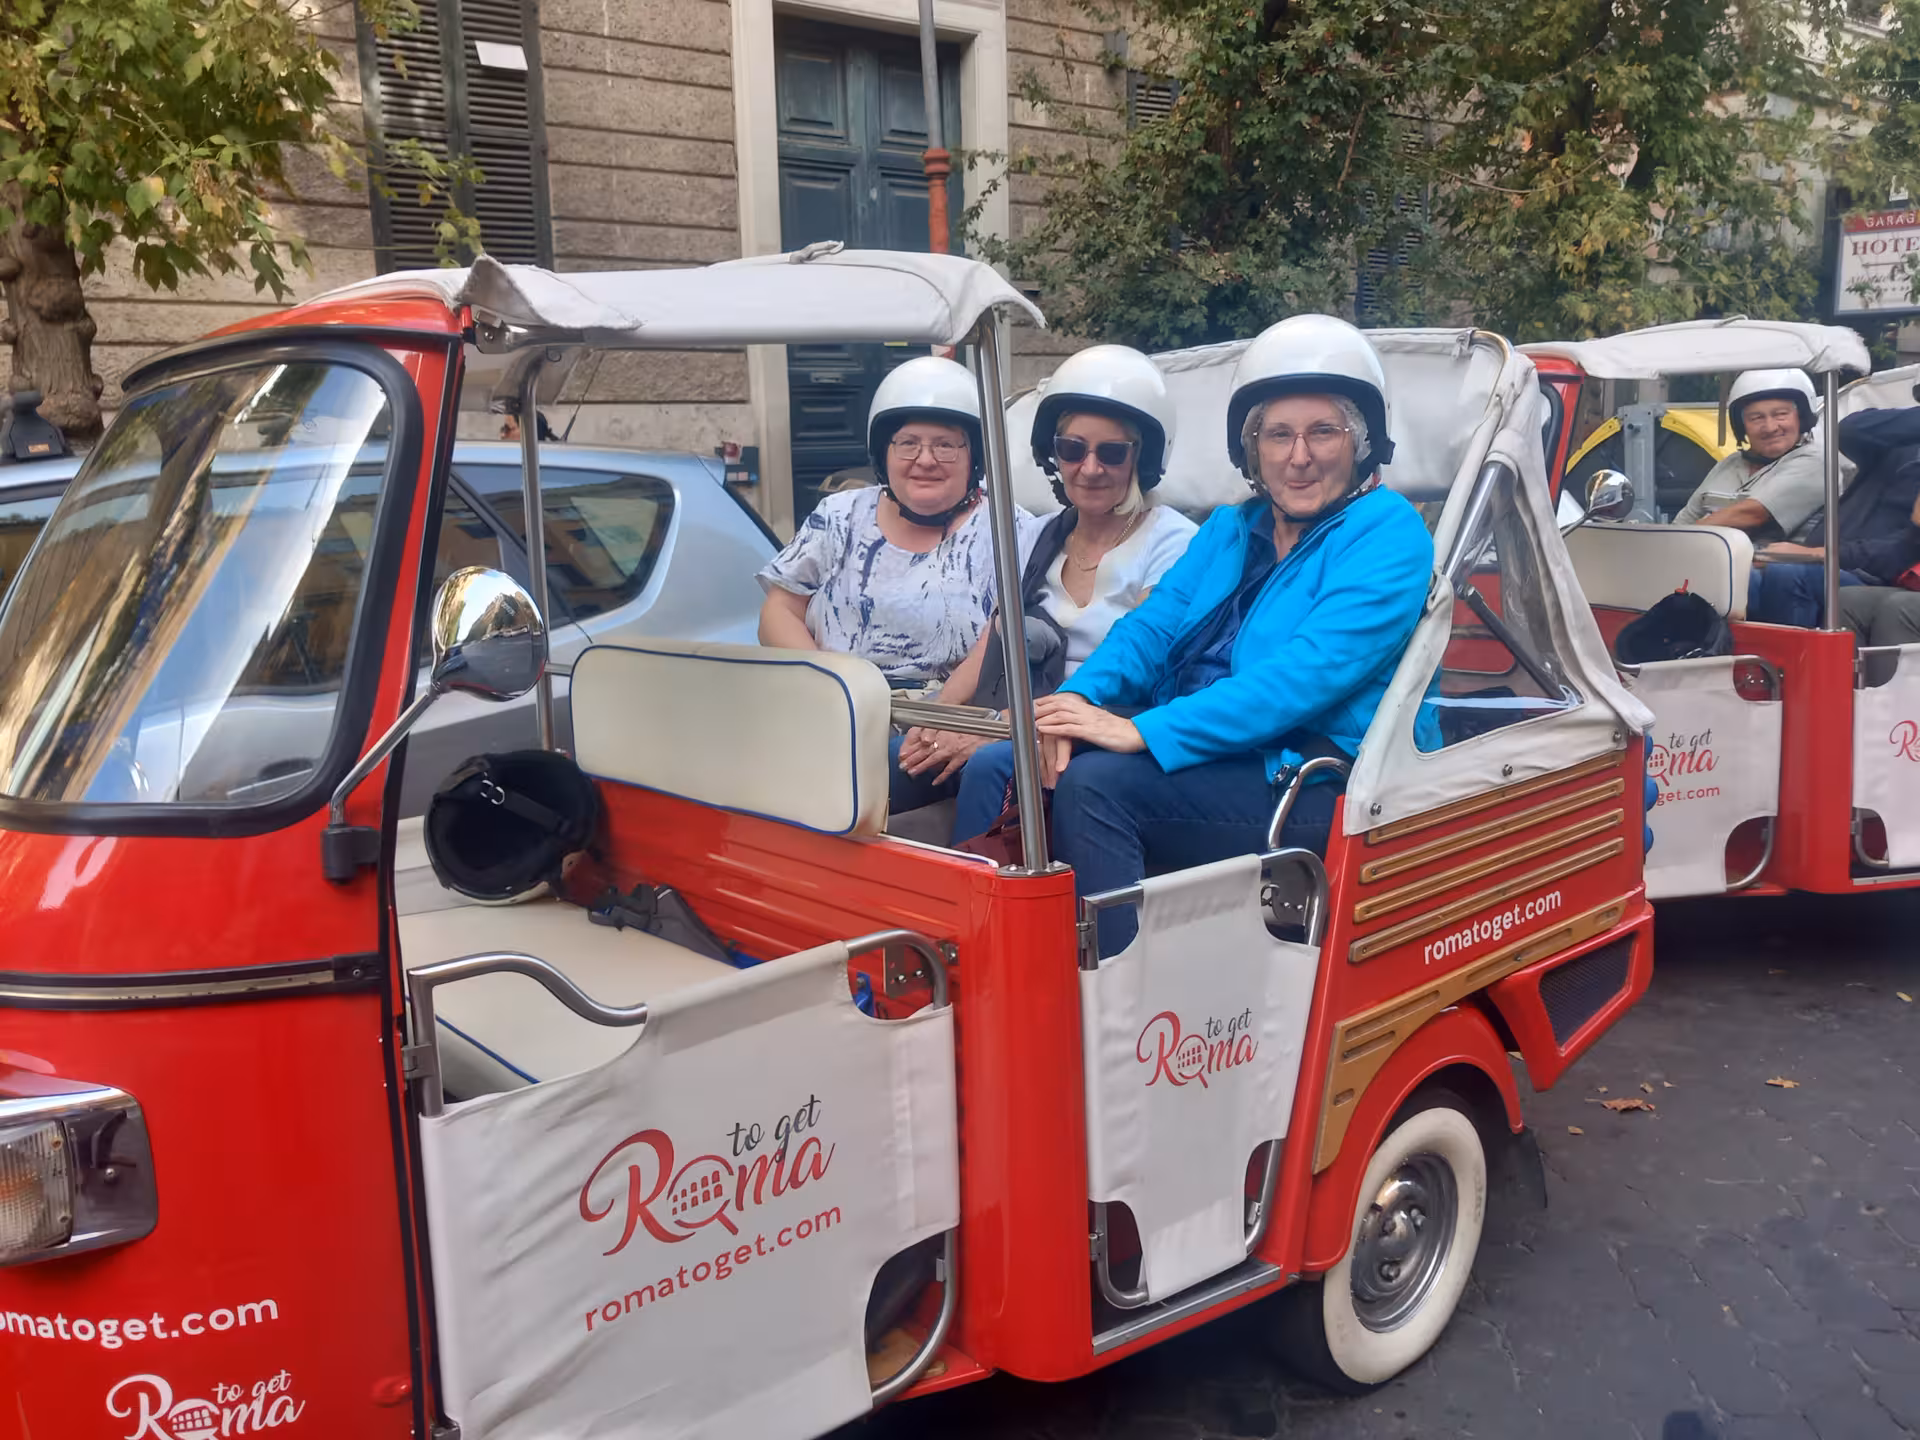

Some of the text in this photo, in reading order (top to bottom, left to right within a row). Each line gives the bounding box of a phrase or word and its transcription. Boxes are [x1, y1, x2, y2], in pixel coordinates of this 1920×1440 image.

[1865, 213, 1915, 228] GARAG
[1851, 236, 1920, 256] HOTE
[1668, 728, 1712, 757] to get
[1656, 787, 1720, 806] get.com
[1424, 890, 1561, 965] romatoget.com
[1136, 1010, 1259, 1088] Roma
[1205, 1007, 1252, 1047] to get
[727, 1093, 822, 1163] to get
[579, 1128, 836, 1256] Roma
[585, 1206, 842, 1331] romatoget.com
[0, 1298, 279, 1348] matoget.com
[105, 1373, 306, 1440] Roma
[211, 1369, 292, 1404] to get
